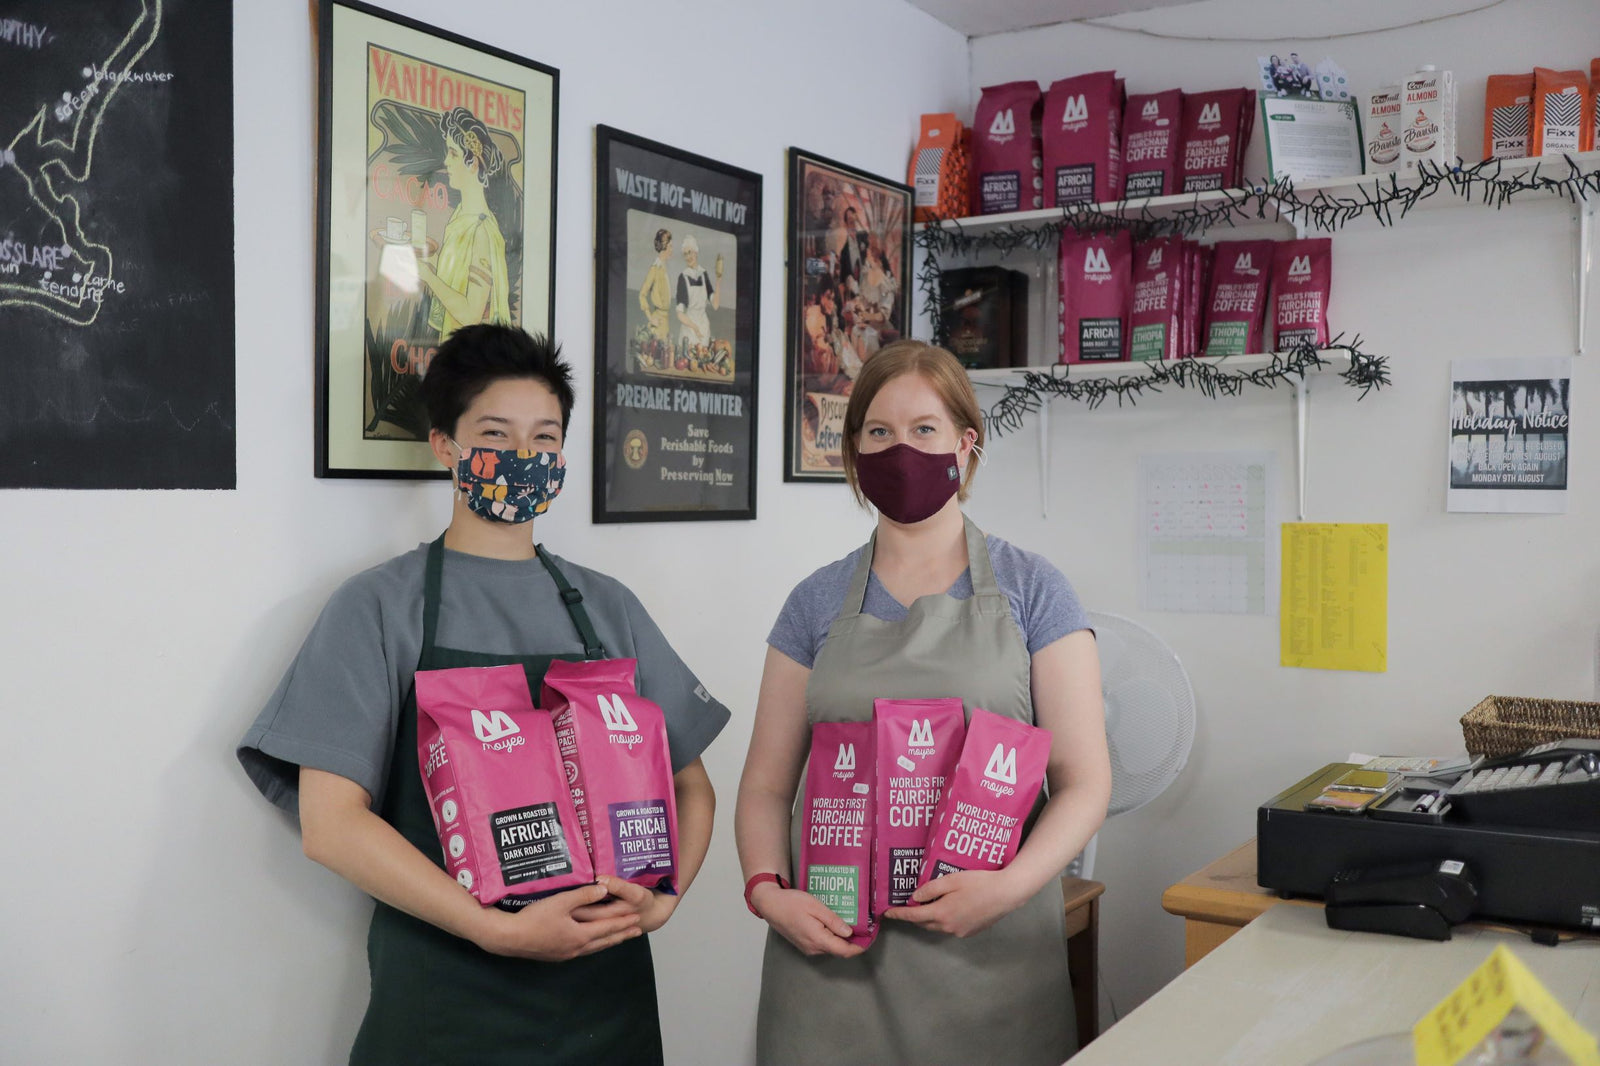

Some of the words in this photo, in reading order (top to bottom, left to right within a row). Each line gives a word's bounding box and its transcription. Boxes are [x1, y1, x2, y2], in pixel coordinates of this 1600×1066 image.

[1407, 90, 1438, 102] ALMOND
[1371, 104, 1400, 115] ALMOND
[1126, 146, 1167, 162] COFFEE
[1186, 145, 1229, 158] FAIRCHAIN
[1546, 142, 1575, 150] ORGANIC
[1184, 155, 1228, 170] COFFEE
[373, 163, 449, 210] CACAO
[984, 181, 1012, 193] AFRICA
[1058, 174, 1087, 187] AFRICA
[1127, 177, 1156, 190] AFRICA
[1184, 180, 1215, 192] AFRICA
[615, 168, 658, 202] WASTE
[725, 201, 747, 225] NOT
[0, 240, 64, 270] SSLARE
[1215, 289, 1257, 299] FAIRCHAIN
[1304, 291, 1322, 299] FIRST
[1133, 296, 1167, 313] COFFEE
[1213, 299, 1254, 312] COFFEE
[1278, 299, 1320, 311] FAIRCHAIN
[1278, 309, 1320, 325] COFFEE
[1083, 328, 1114, 339] AFRICA
[617, 383, 671, 411] PREPARE
[674, 389, 697, 413] FOR
[699, 392, 743, 417] WINTER
[1453, 408, 1517, 438] Holiday
[1522, 406, 1569, 429] Notice
[687, 424, 710, 438] Save
[661, 437, 707, 452] Perishable
[708, 440, 734, 454] Foods
[692, 455, 704, 468] by
[1534, 453, 1561, 461] AUGUST
[1478, 463, 1496, 471] BACK
[1498, 463, 1516, 471] OPEN
[1517, 463, 1539, 471] AGAIN
[661, 467, 714, 485] Preserving
[715, 469, 733, 482] Now
[1472, 474, 1500, 483] MONDAY
[1502, 474, 1516, 482] 9TH
[1518, 474, 1544, 483] AUGUST
[482, 735, 526, 753] moyee
[889, 777, 930, 788] WORLD'S
[932, 776, 946, 787] FIR
[980, 779, 1015, 798] moyee
[812, 798, 845, 809] WORLD'S
[845, 798, 867, 809] FIRST
[495, 814, 518, 826] GROWN
[523, 808, 547, 819] ROASTED
[548, 807, 554, 815] IN
[616, 809, 635, 817] GROWN
[640, 807, 659, 815] ROASTED
[811, 809, 864, 825] FAIRCHAIN
[889, 806, 938, 827] COFF
[956, 800, 995, 823] WORLD'S
[996, 814, 1019, 828] FIRST
[500, 821, 551, 847] AFRICA
[619, 818, 661, 838] AFRICA
[810, 825, 864, 847] COFFEE
[950, 813, 1012, 843] FAIRCHAIN
[503, 848, 523, 861] DARK
[524, 844, 546, 857] ROAST
[620, 838, 652, 854] TRIPLE
[944, 829, 1008, 864] COFFEE
[893, 858, 922, 875] AFR
[809, 876, 855, 892] ETHIOPIA
